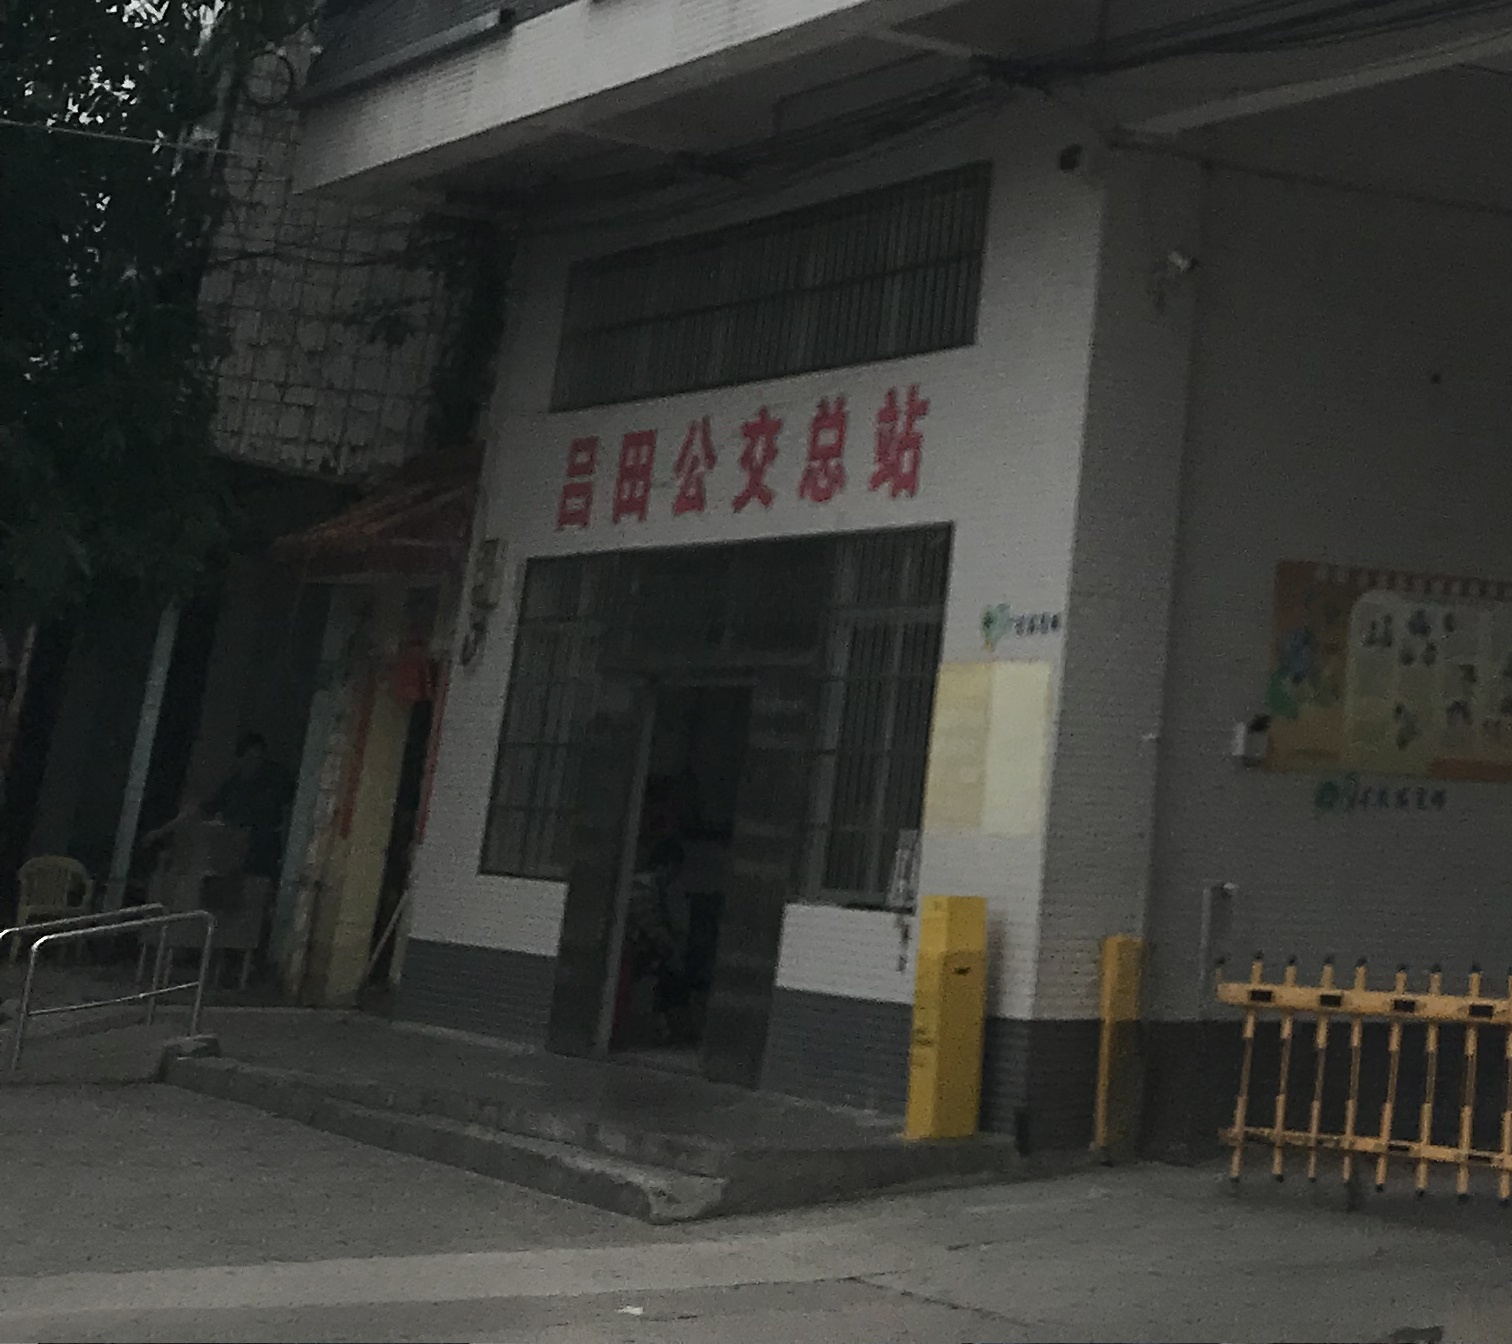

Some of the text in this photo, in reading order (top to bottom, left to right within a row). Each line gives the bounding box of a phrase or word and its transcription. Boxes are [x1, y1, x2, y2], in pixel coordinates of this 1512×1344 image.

[556, 384, 931, 531] 吕田公交总站
